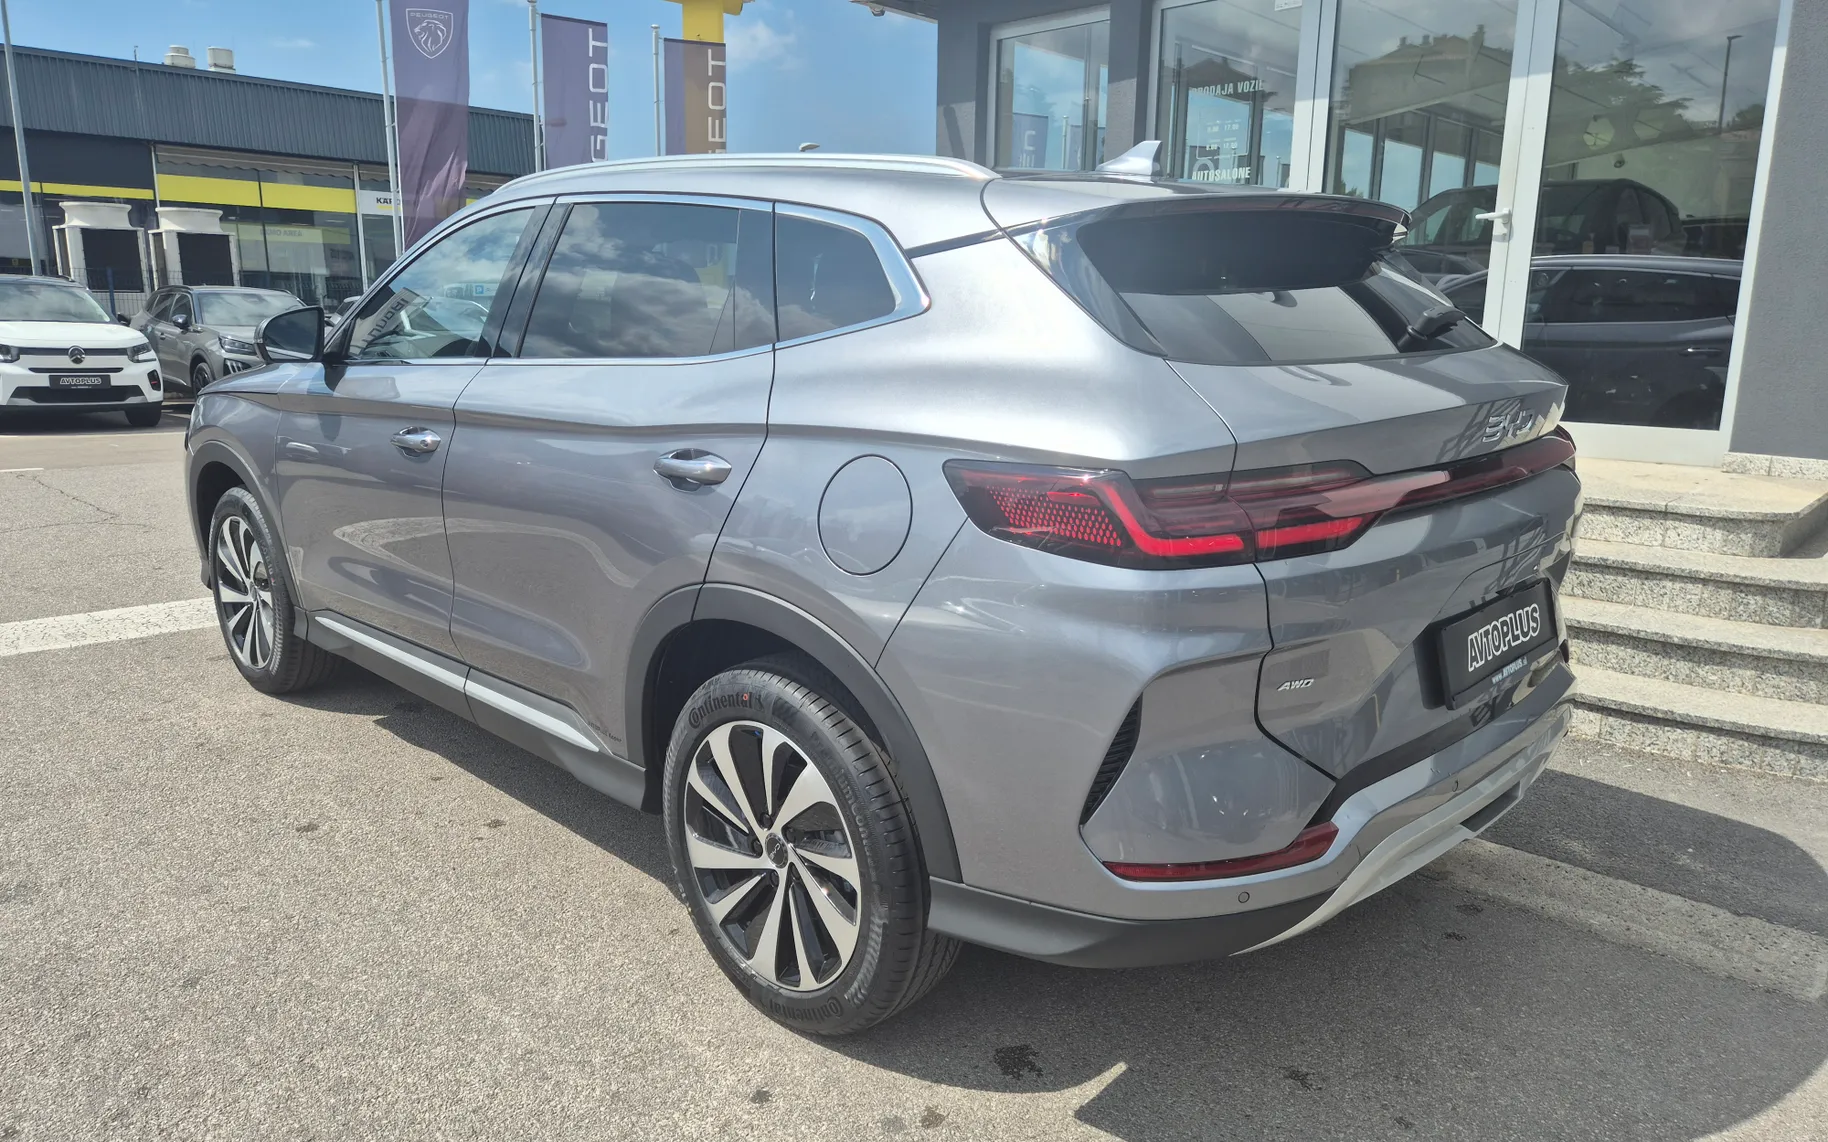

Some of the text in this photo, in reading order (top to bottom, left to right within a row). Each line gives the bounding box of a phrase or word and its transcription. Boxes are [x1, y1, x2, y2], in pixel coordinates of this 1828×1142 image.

[410, 12, 448, 20] PEUGEOT
[60, 377, 102, 385] AVTOPLUS
[1482, 410, 1533, 443] BYD
[1468, 603, 1540, 672] AVTOPLUS
[1277, 678, 1314, 691] AWD
[688, 690, 753, 729] Continental
